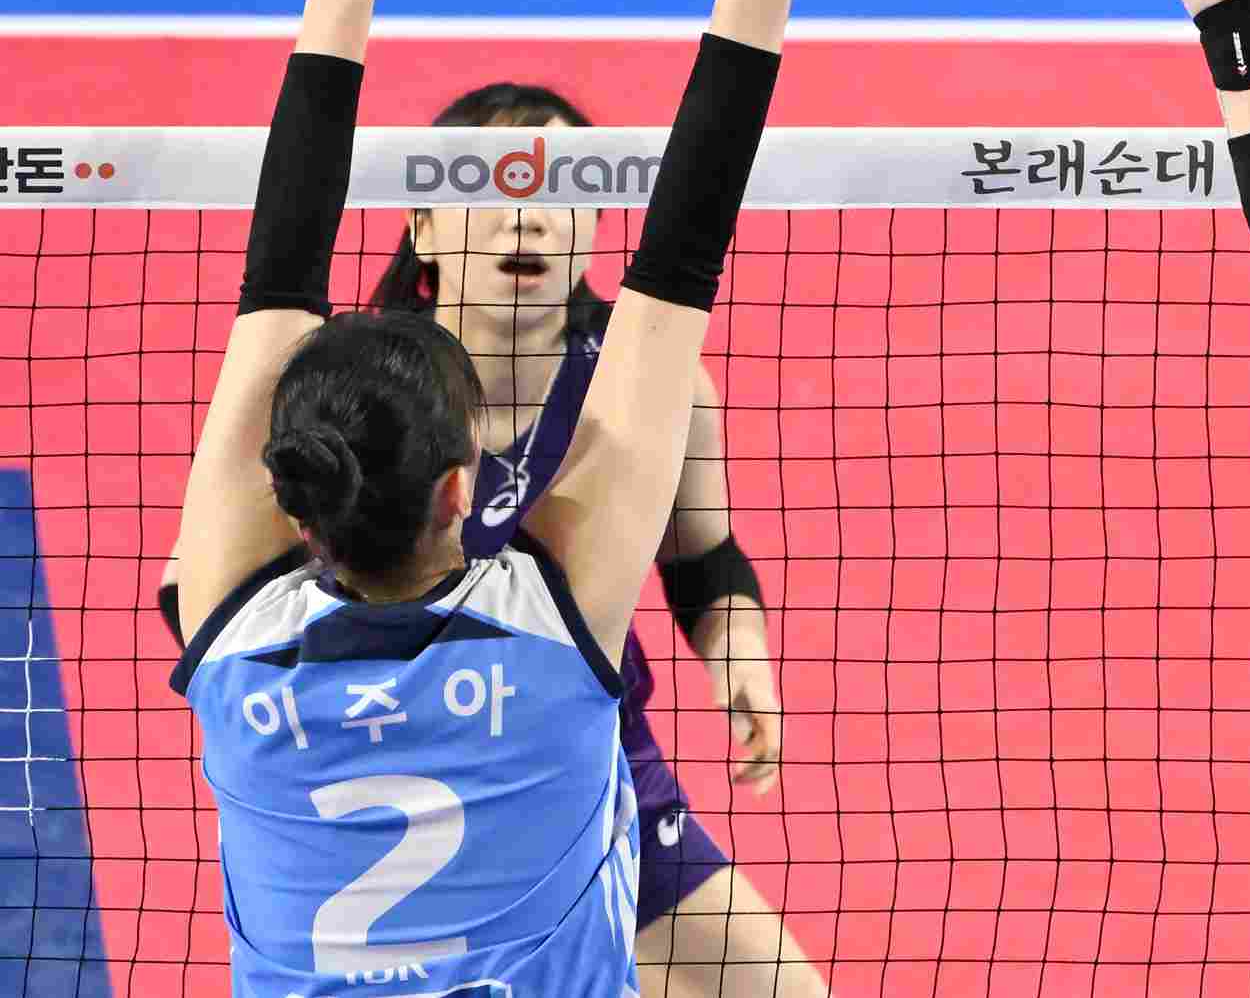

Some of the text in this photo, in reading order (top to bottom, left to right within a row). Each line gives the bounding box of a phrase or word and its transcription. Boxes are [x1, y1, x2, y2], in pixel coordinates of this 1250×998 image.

[0, 146, 64, 194] 돈
[961, 138, 1216, 197] 본래순대
[309, 774, 468, 973] 2
